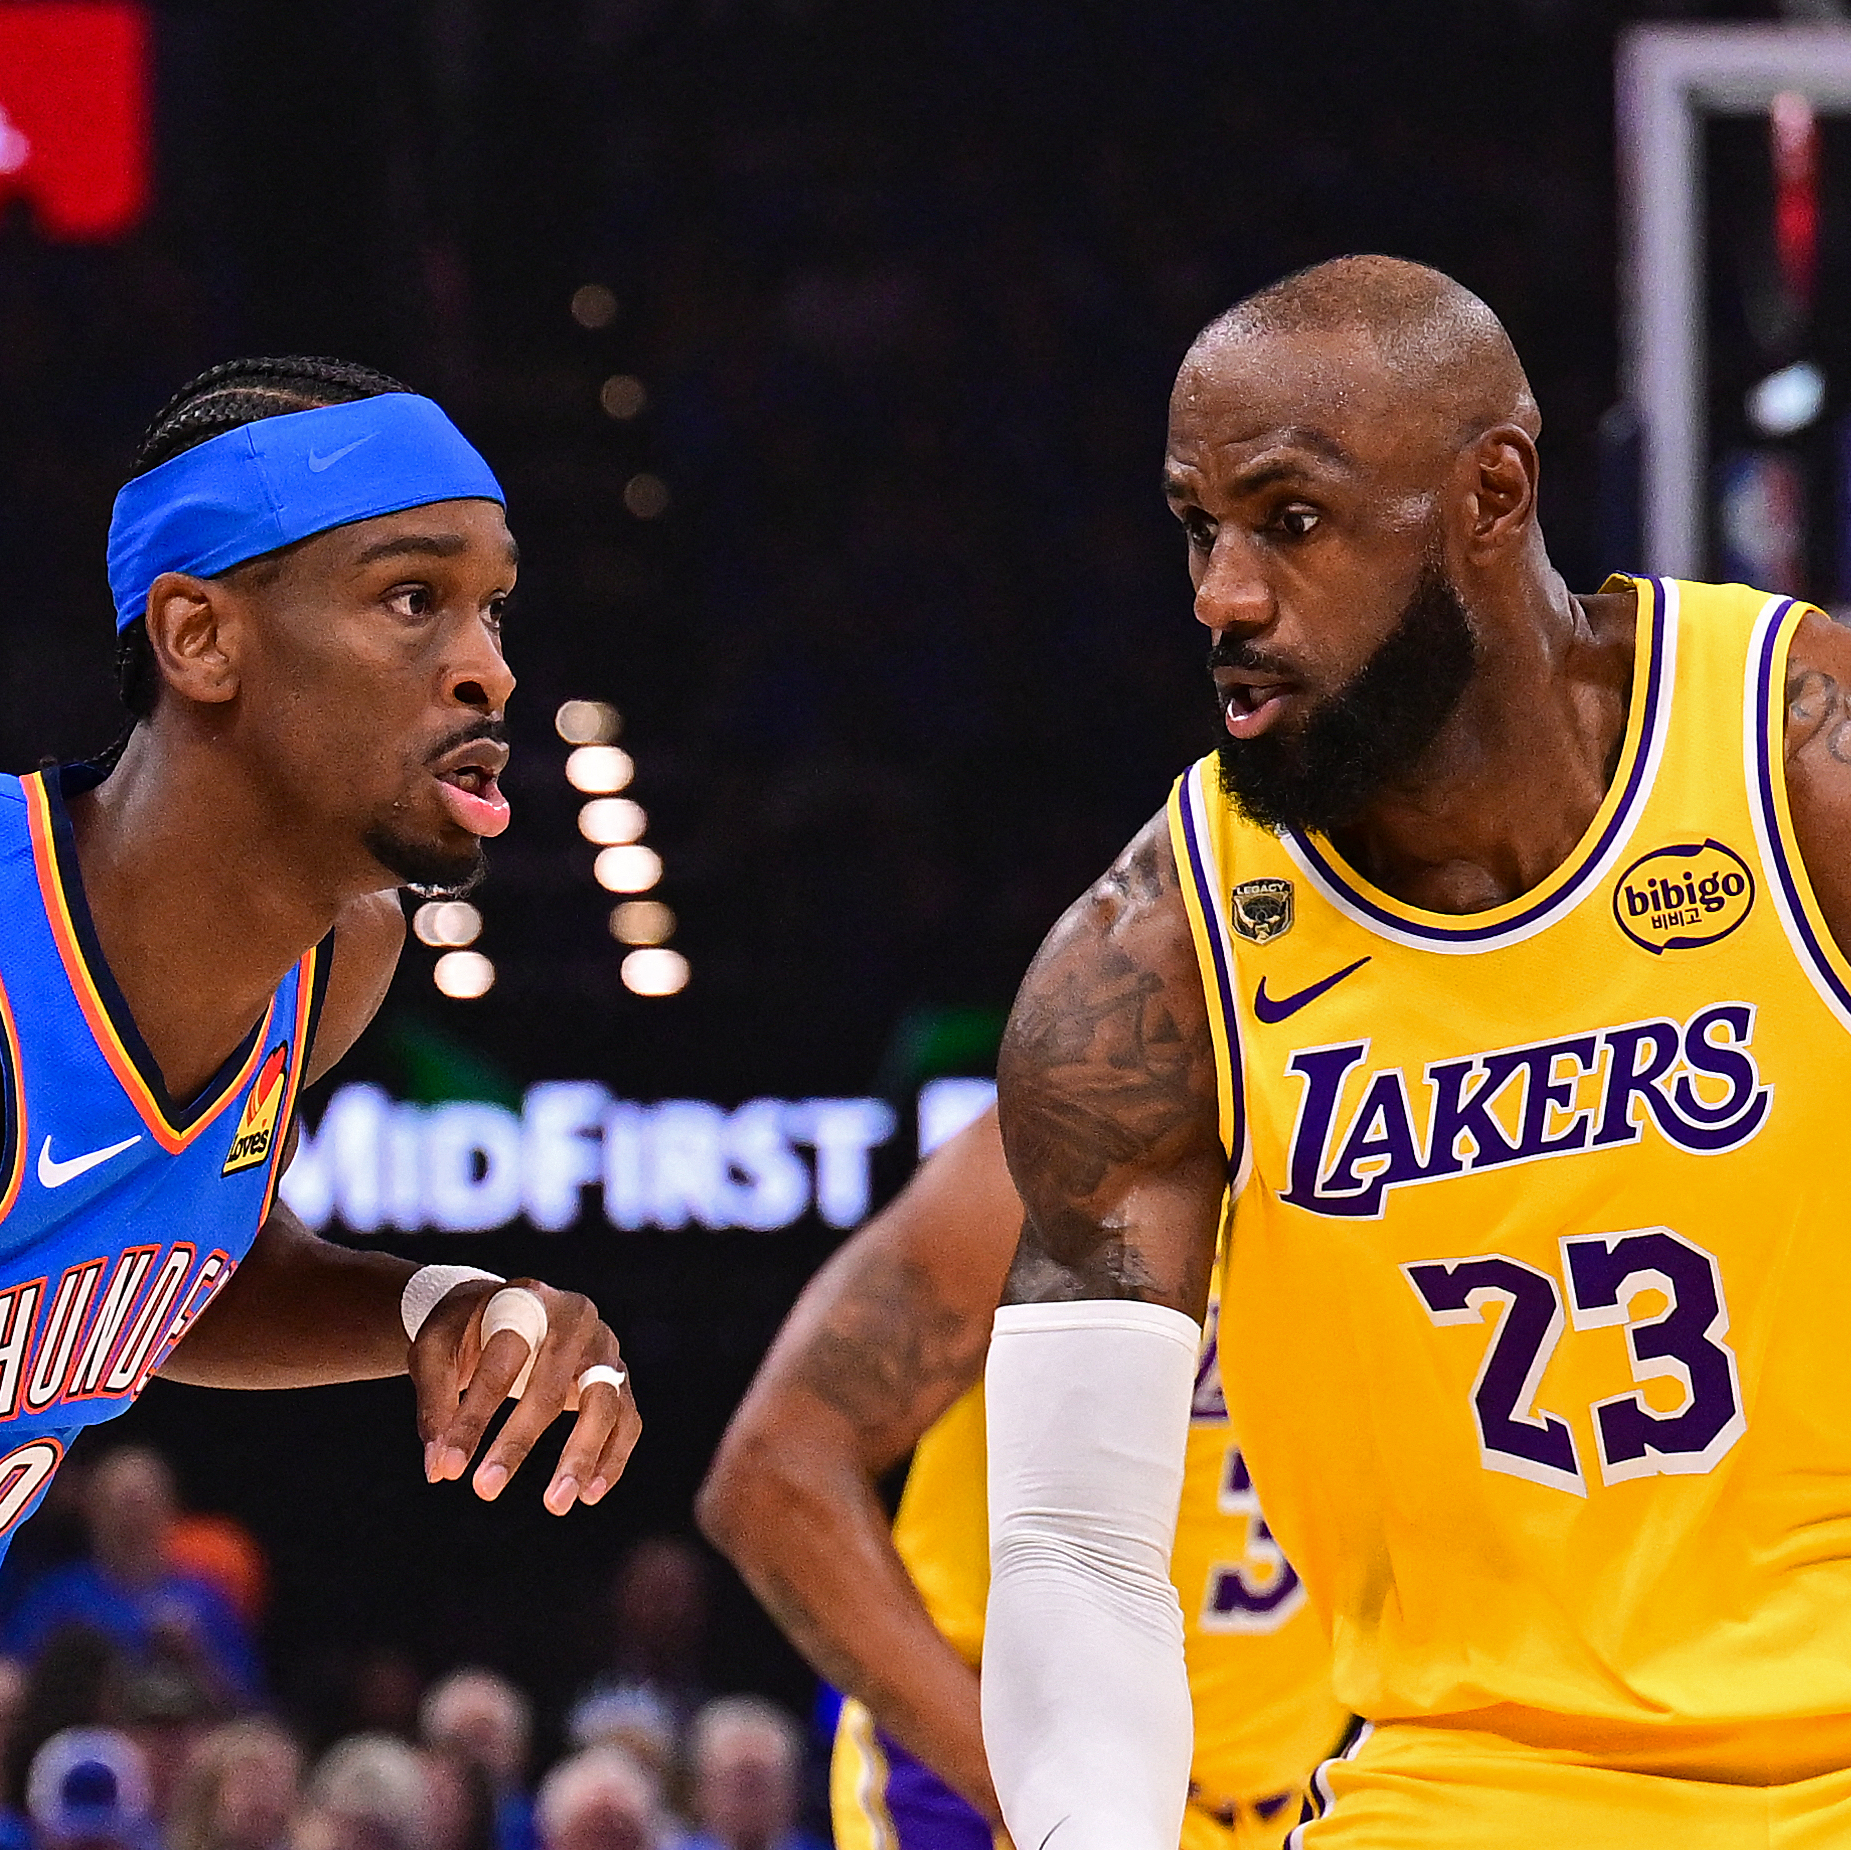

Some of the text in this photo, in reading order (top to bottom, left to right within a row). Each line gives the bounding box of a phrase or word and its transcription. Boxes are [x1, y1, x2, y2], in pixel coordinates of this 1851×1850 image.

[1236, 882, 1286, 896] LEGACY
[1624, 870, 1746, 917] bibigo
[1651, 907, 1703, 931] 비비고
[1277, 1001, 1775, 1221] LAKERS
[1397, 1225, 1748, 1499] 23
